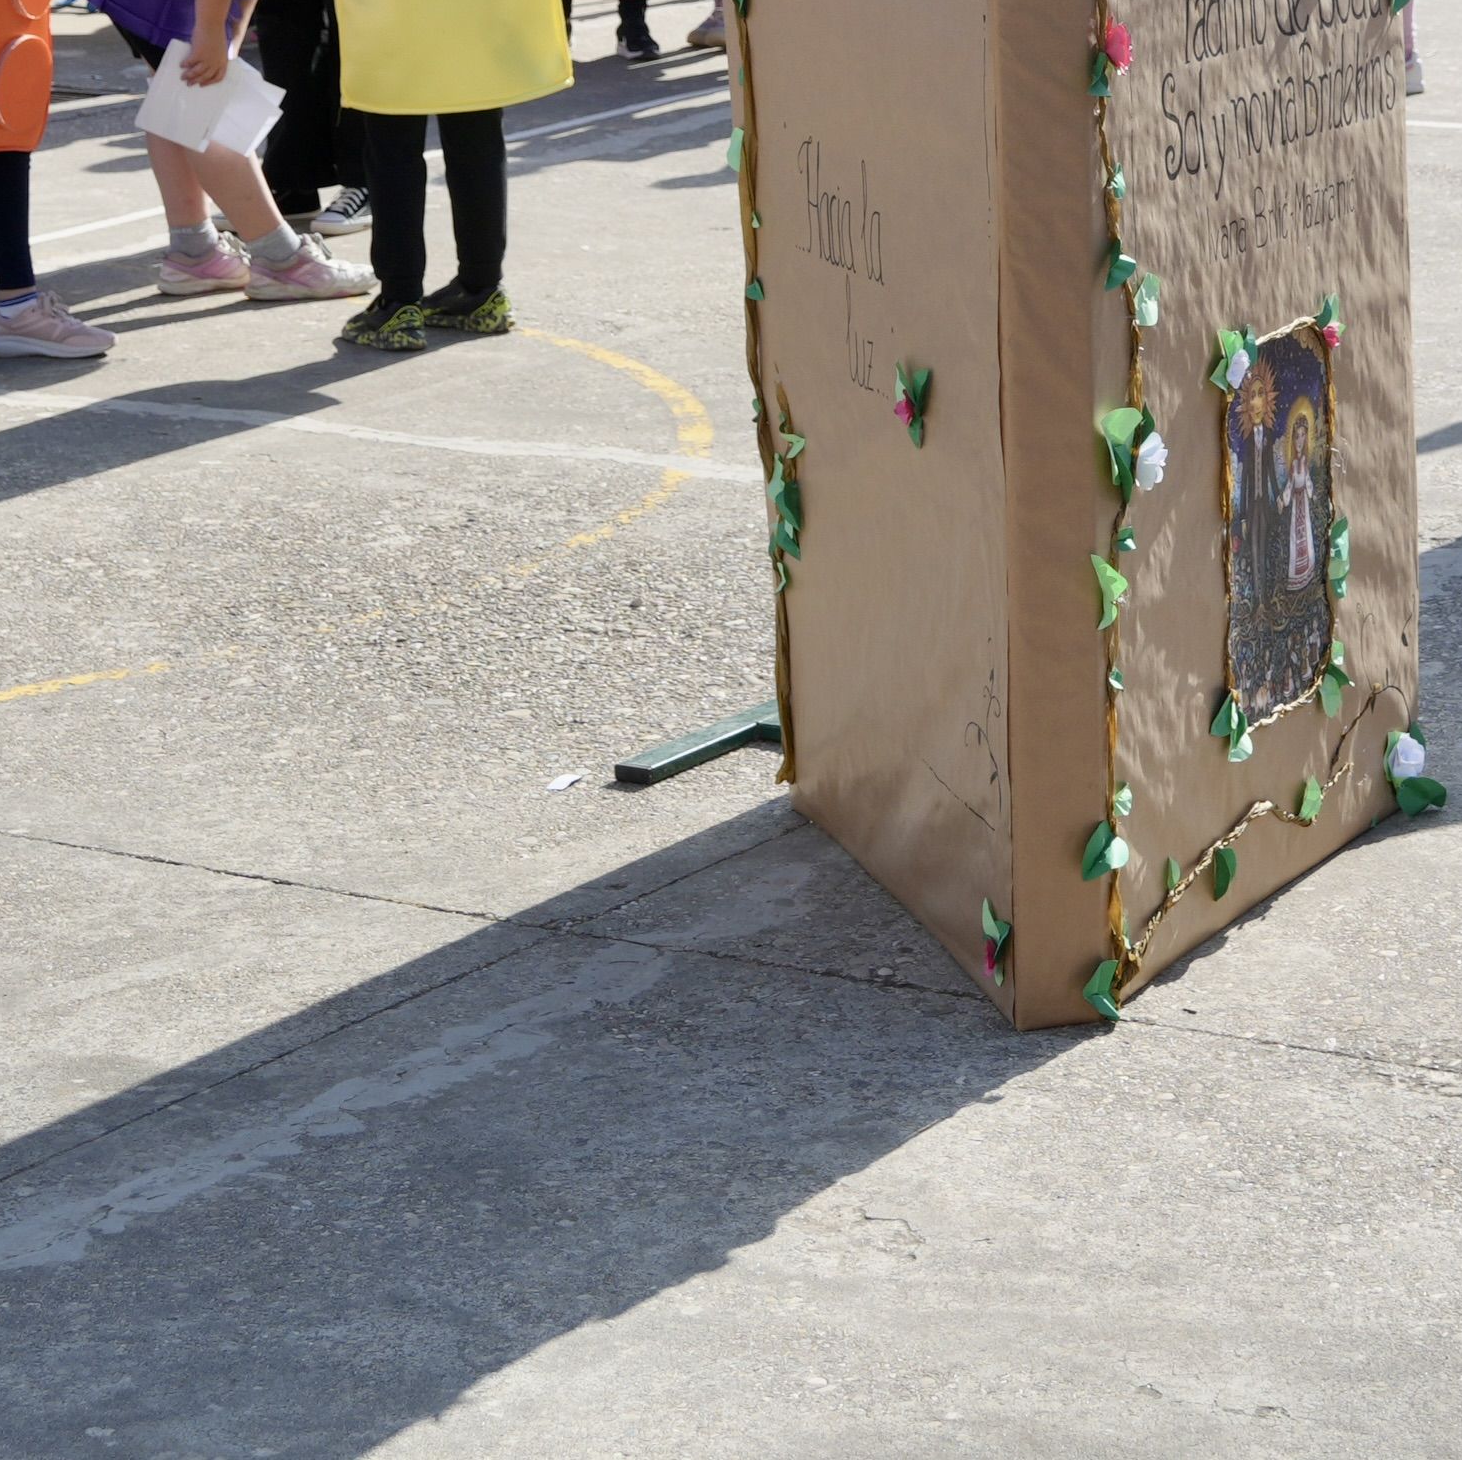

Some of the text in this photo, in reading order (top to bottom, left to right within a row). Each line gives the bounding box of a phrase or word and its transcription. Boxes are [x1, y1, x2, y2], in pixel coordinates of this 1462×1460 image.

[1161, 67, 1209, 182] Sol
[1211, 111, 1227, 202] y
[1229, 75, 1299, 162] novia
[860, 159, 885, 287] la
